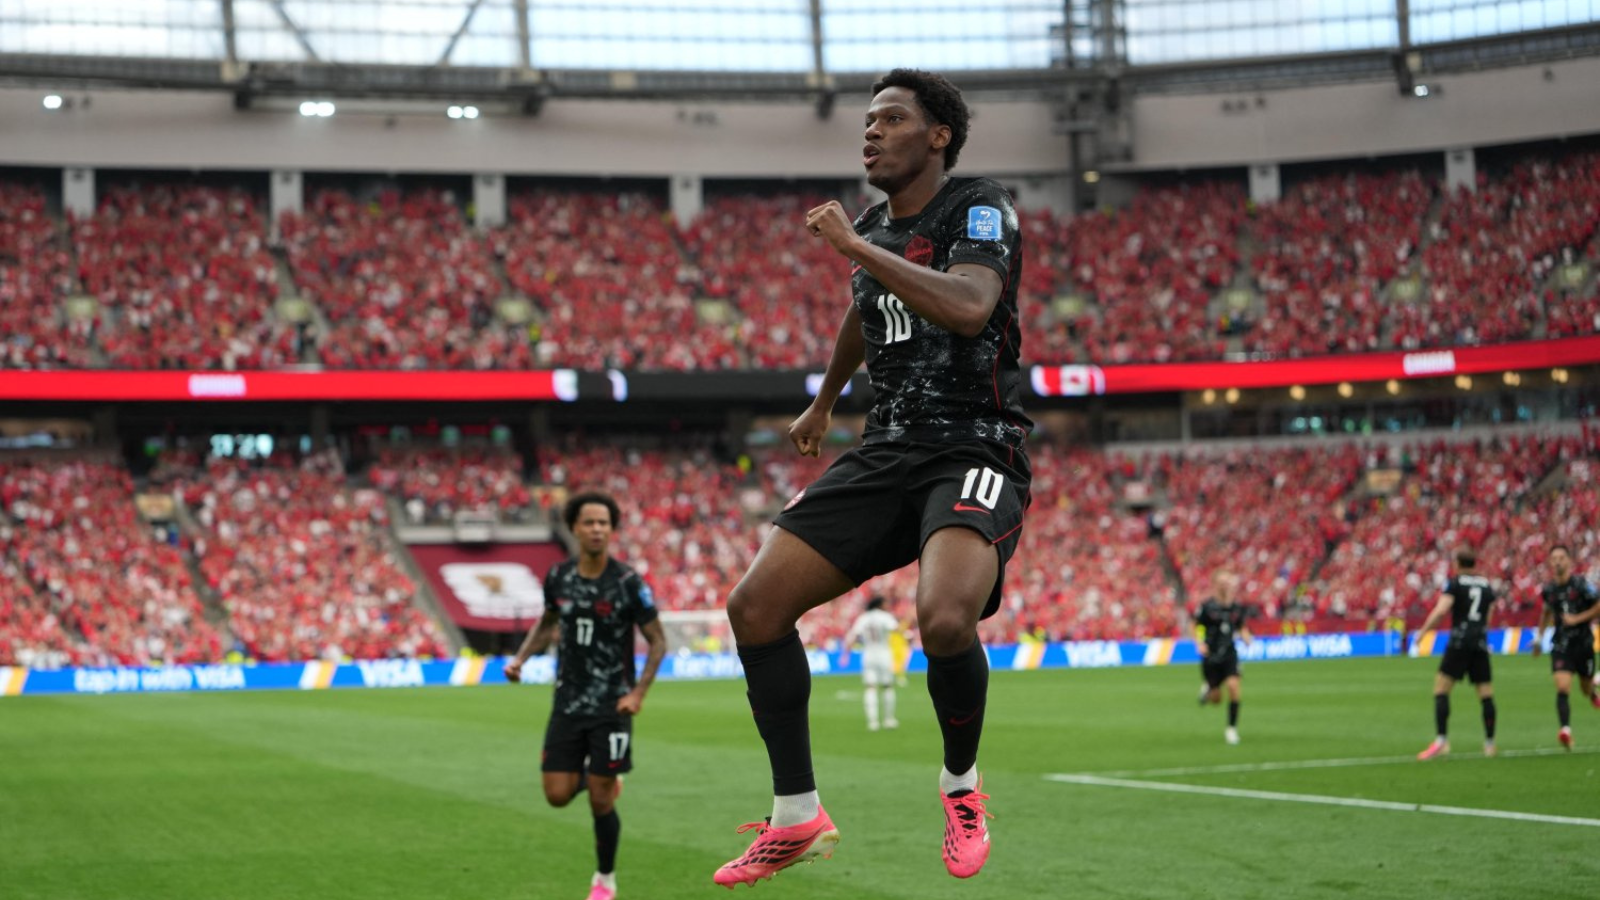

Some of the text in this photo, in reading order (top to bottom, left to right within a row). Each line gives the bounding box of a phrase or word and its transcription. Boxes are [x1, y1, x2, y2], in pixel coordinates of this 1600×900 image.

[877, 293, 912, 345] 10
[960, 466, 1004, 510] 10
[1467, 587, 1482, 622] 2
[576, 617, 594, 646] 17
[1308, 633, 1353, 657] VISA
[1063, 639, 1122, 667] VISA
[194, 664, 246, 689] VISA
[359, 659, 425, 688] VISA
[608, 732, 629, 760] 17
